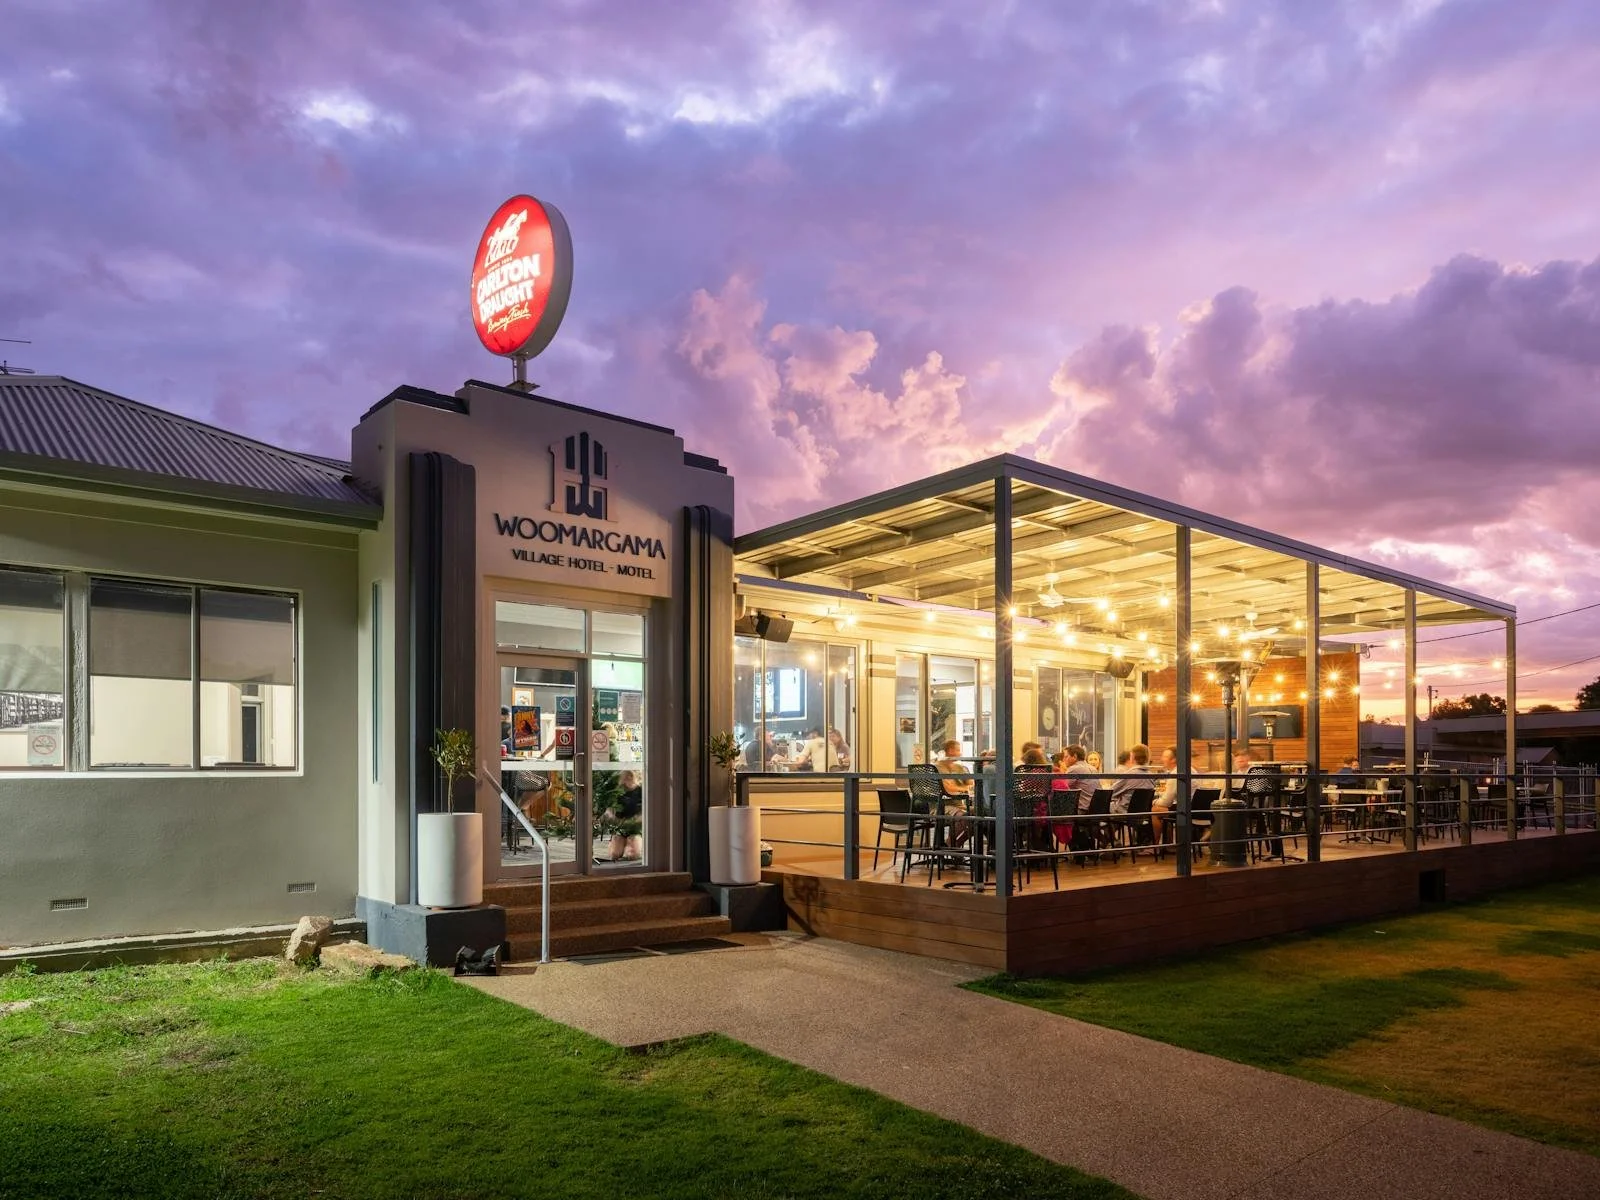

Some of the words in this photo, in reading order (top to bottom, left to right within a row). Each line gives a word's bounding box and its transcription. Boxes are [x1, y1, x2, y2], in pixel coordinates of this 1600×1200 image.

[477, 254, 540, 304] CARLTON
[479, 279, 534, 324] DRAUGHT
[494, 513, 666, 560] WOOMARGAMA
[511, 549, 565, 567] VILLAGE
[567, 556, 609, 573] HOTEL
[616, 564, 656, 580] MOTEL
